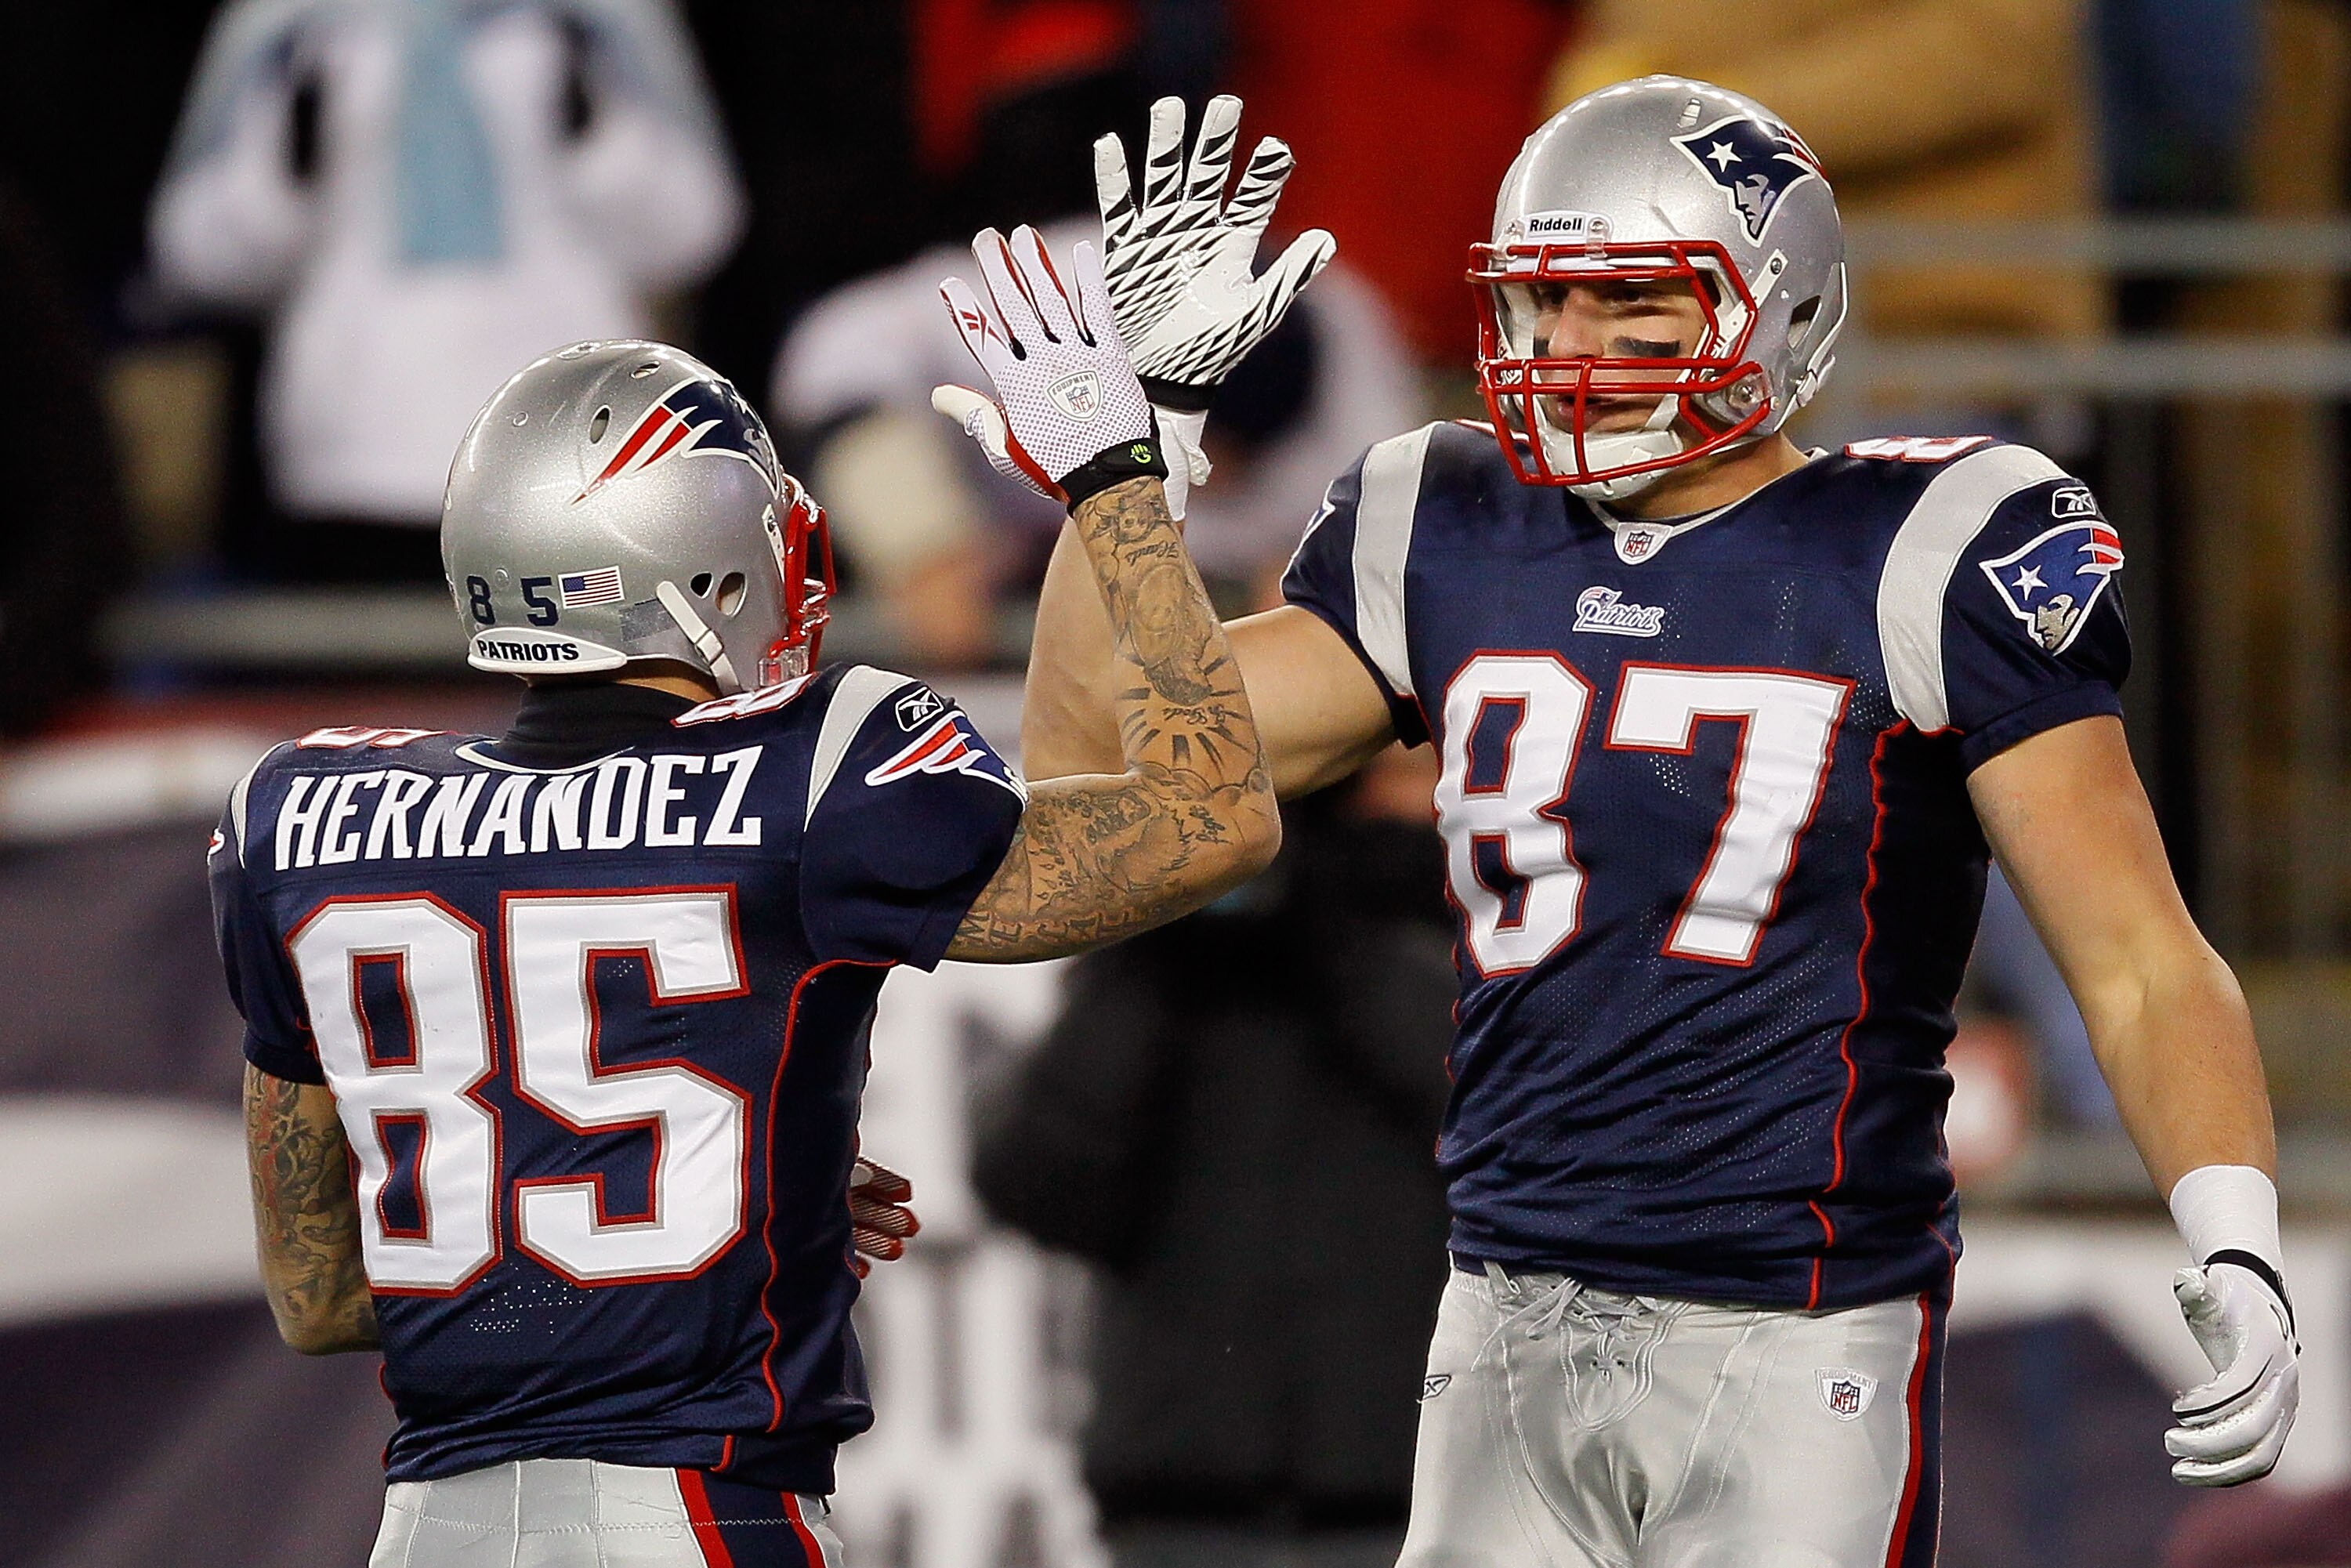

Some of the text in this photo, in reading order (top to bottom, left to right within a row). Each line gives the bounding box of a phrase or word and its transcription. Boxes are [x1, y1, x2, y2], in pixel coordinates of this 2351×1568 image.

[1530, 218, 1582, 232] Riddell
[1052, 373, 1095, 396] EQUIPMENT
[1070, 395, 1096, 414] NFL
[1625, 541, 1649, 555] NFL
[466, 575, 560, 626] 8 5
[1574, 599, 1664, 632] Patriots
[476, 639, 580, 661] PATRIOTS
[274, 745, 763, 871] HERNANDEZ
[1433, 647, 1856, 980] 87
[284, 882, 752, 1298] 85
[1833, 1393, 1857, 1410] NFL
